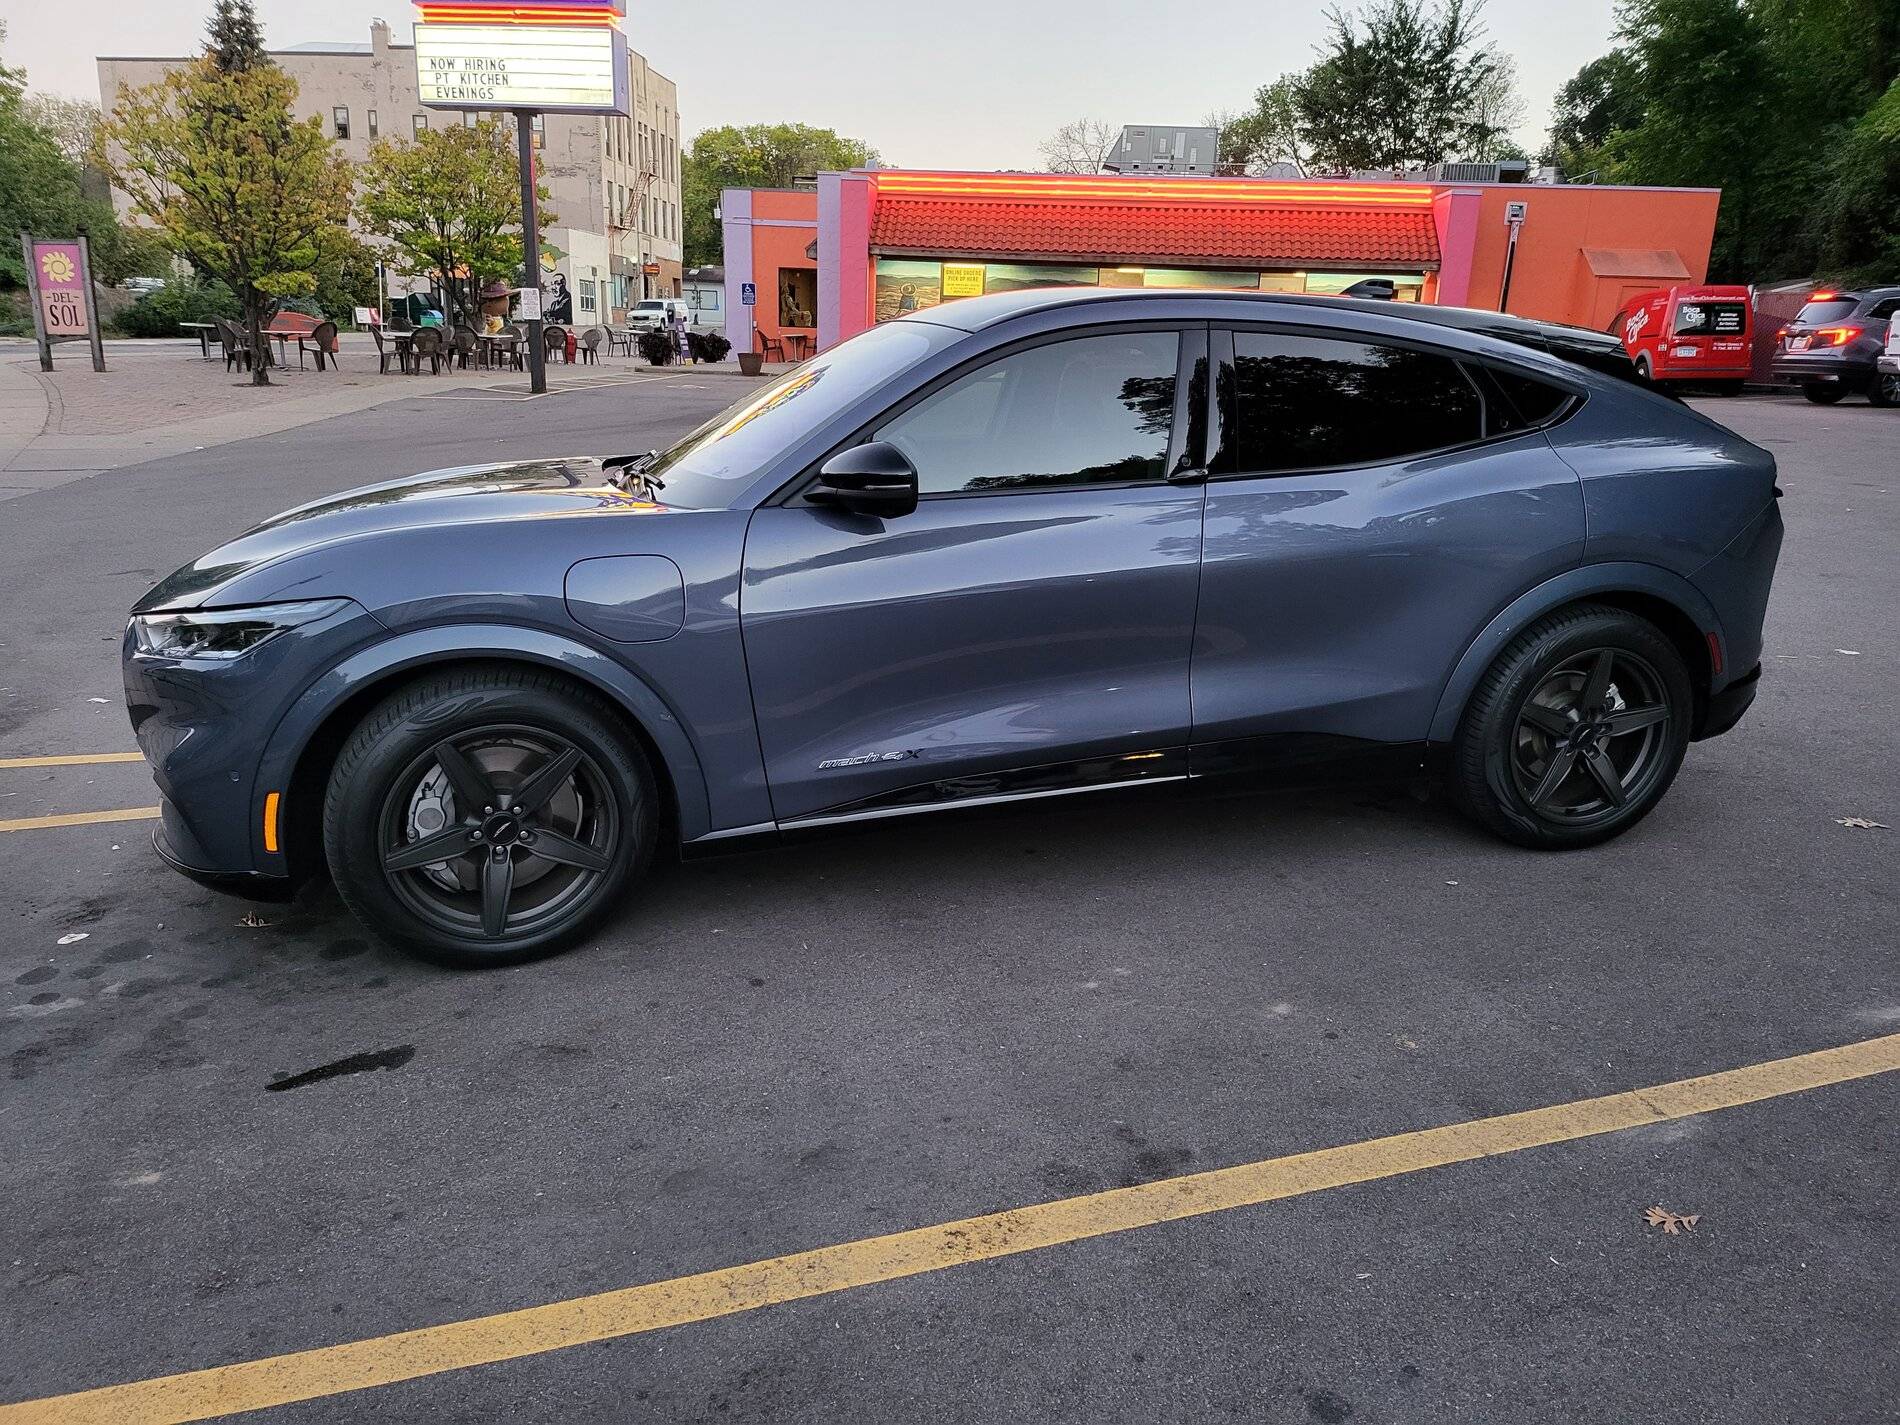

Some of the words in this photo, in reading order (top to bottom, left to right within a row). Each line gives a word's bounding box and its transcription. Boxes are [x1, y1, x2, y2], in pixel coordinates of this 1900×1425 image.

[430, 58, 455, 70] NOW
[464, 59, 506, 72] HIRING
[435, 73, 449, 85] PT
[460, 73, 509, 86] KITCHEN
[436, 87, 495, 100] EVENINGS
[52, 292, 74, 303] DEL
[49, 304, 84, 327] SOL
